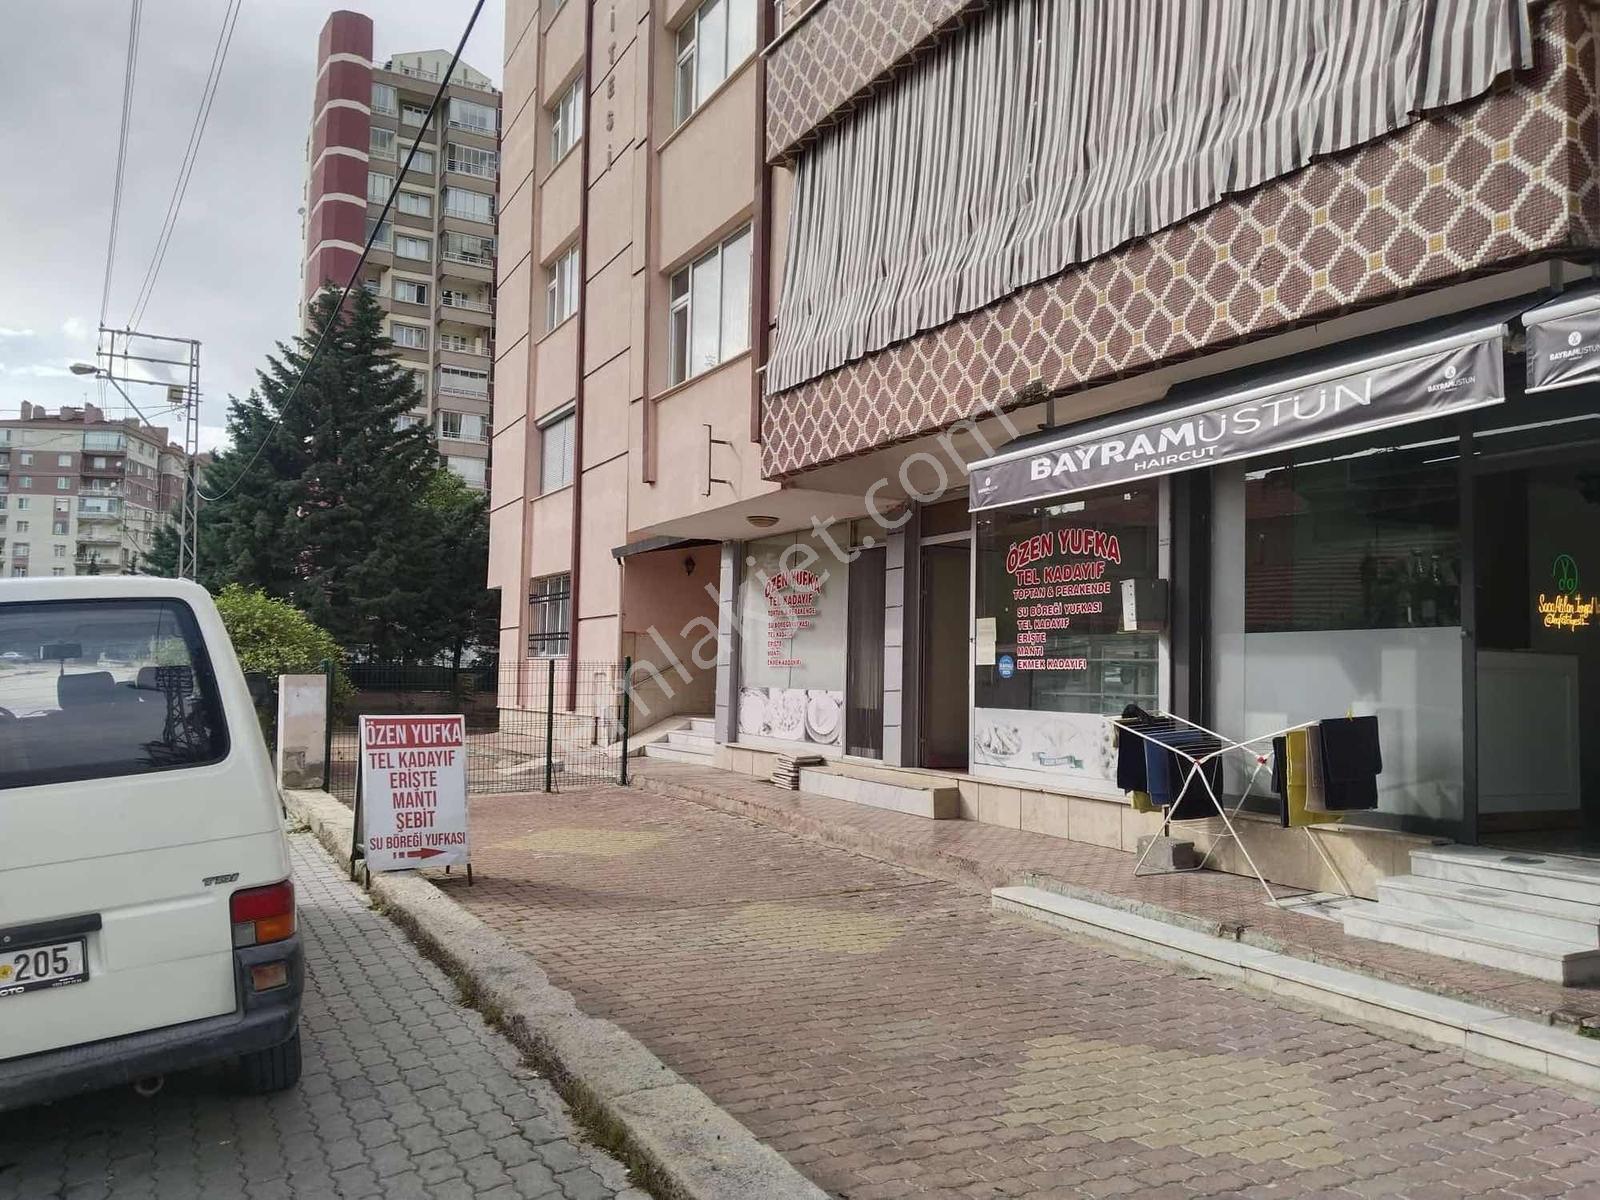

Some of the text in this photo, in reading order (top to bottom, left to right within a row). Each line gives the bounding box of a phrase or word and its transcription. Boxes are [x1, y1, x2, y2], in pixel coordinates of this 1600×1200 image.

[1134, 444, 1218, 472] HAIRCUT
[1006, 528, 1121, 573] ÖZEN YUFKA
[1015, 561, 1105, 585] TEL KADAYIF
[1013, 582, 1111, 600] TOPTAN & PERAKENDE
[1017, 601, 1102, 617] SU BÖREĞİ YUFKASI
[1017, 618, 1070, 630] TEL KADAYIF
[1017, 632, 1046, 645] ERİŞTE
[1017, 646, 1043, 657] MANTI
[1017, 659, 1046, 670] EKMEK
[1047, 659, 1087, 670] KADAYIFI
[366, 721, 462, 746] ÖZEN YUFKA
[369, 750, 456, 769] TEL KADAYIF
[390, 769, 437, 790] ERİŞTE
[393, 790, 437, 809] MANTI
[396, 808, 436, 832] ŞEBİT
[370, 832, 466, 850] SU BÖREĞİ YUFKASI
[14, 947, 69, 982] 205
